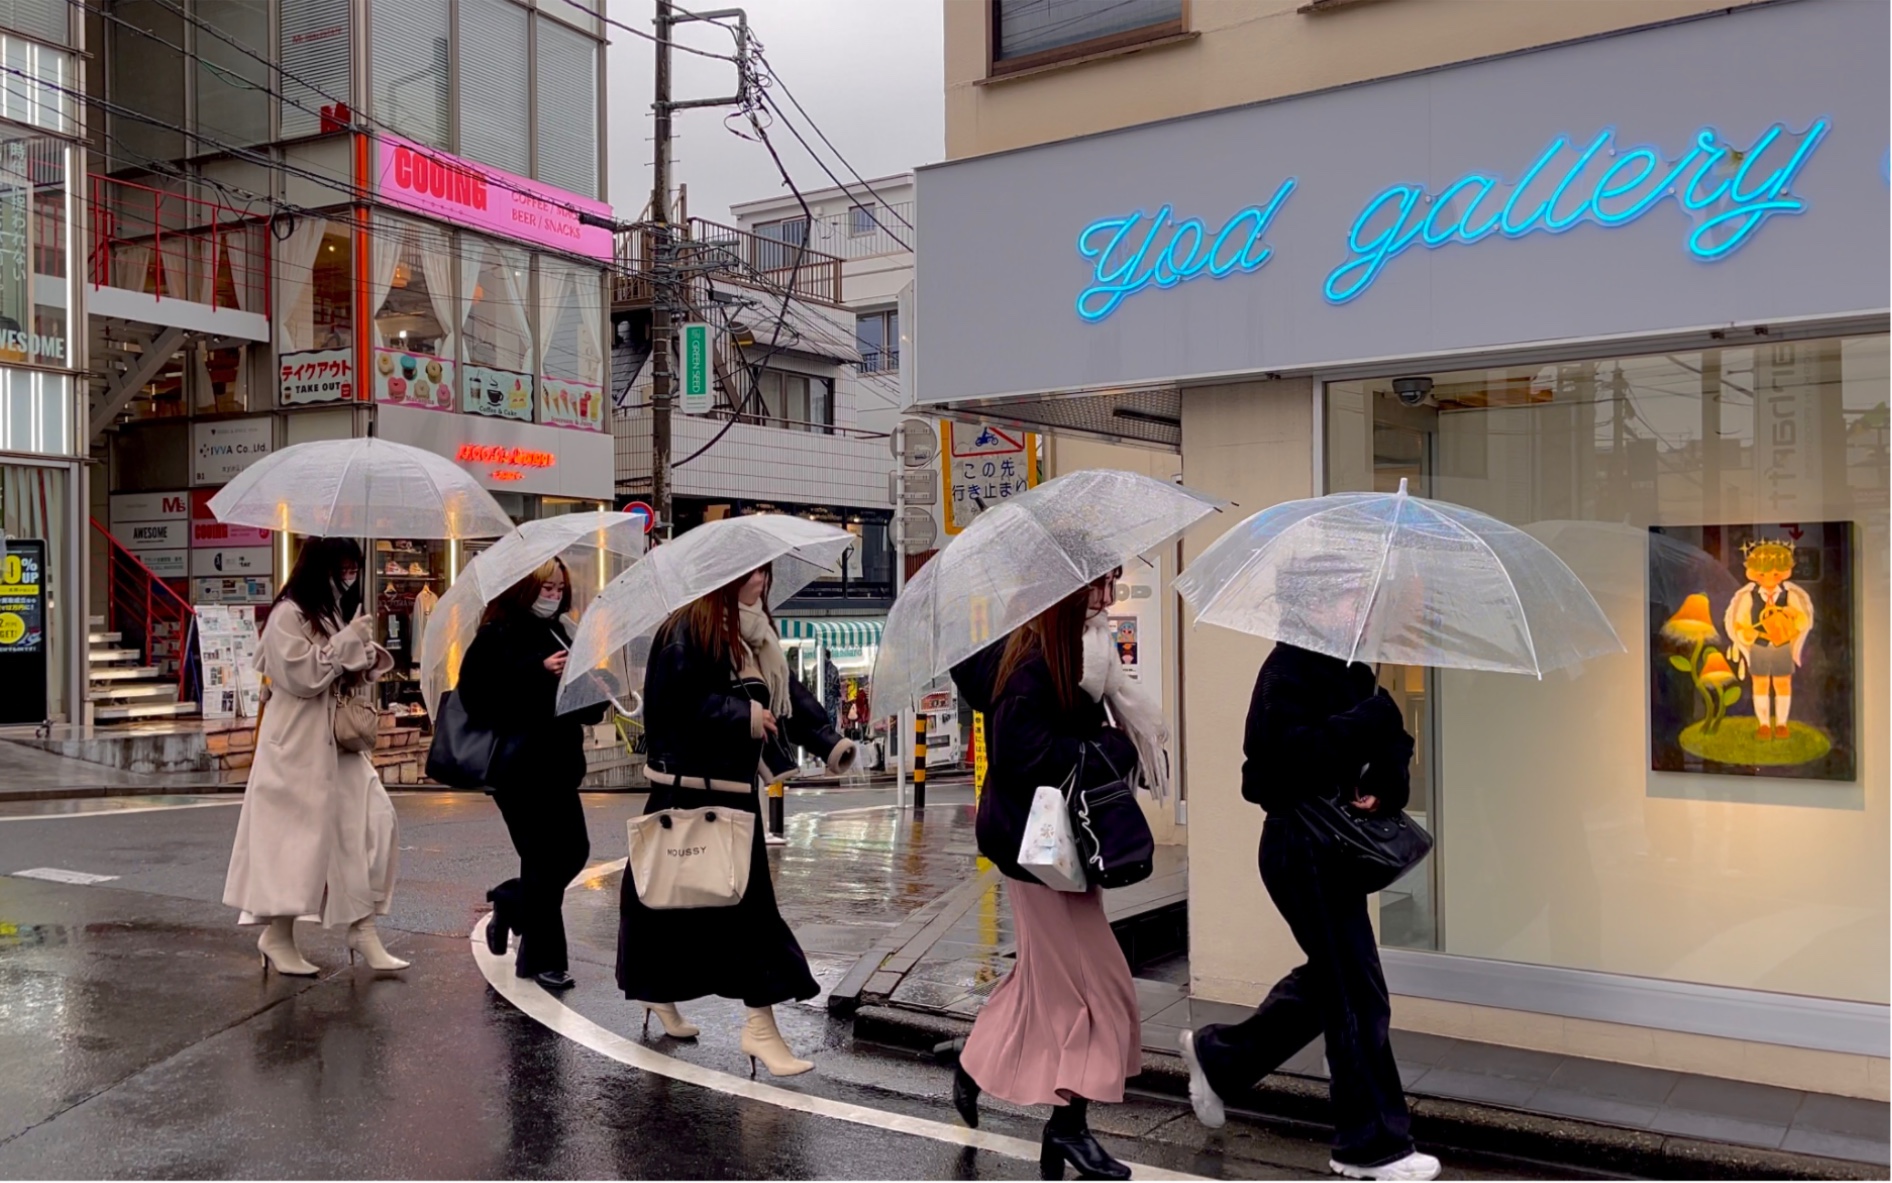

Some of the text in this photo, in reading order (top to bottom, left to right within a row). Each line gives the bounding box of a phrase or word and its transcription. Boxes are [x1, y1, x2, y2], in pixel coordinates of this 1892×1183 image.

[1322, 117, 1828, 303] gallery
[511, 208, 536, 227] BEER
[544, 218, 581, 240] SNACKS
[691, 340, 701, 370] GREEN
[282, 359, 352, 382] テイクアウト
[692, 370, 701, 393] SEED
[295, 381, 340, 394] TAKE OUT
[479, 405, 497, 414] Coffee
[504, 409, 517, 417] Cake
[964, 458, 1016, 480] この先
[952, 479, 1028, 502] 行き止まり
[133, 526, 168, 539] AWESOME
[21, 571, 39, 584] UP
